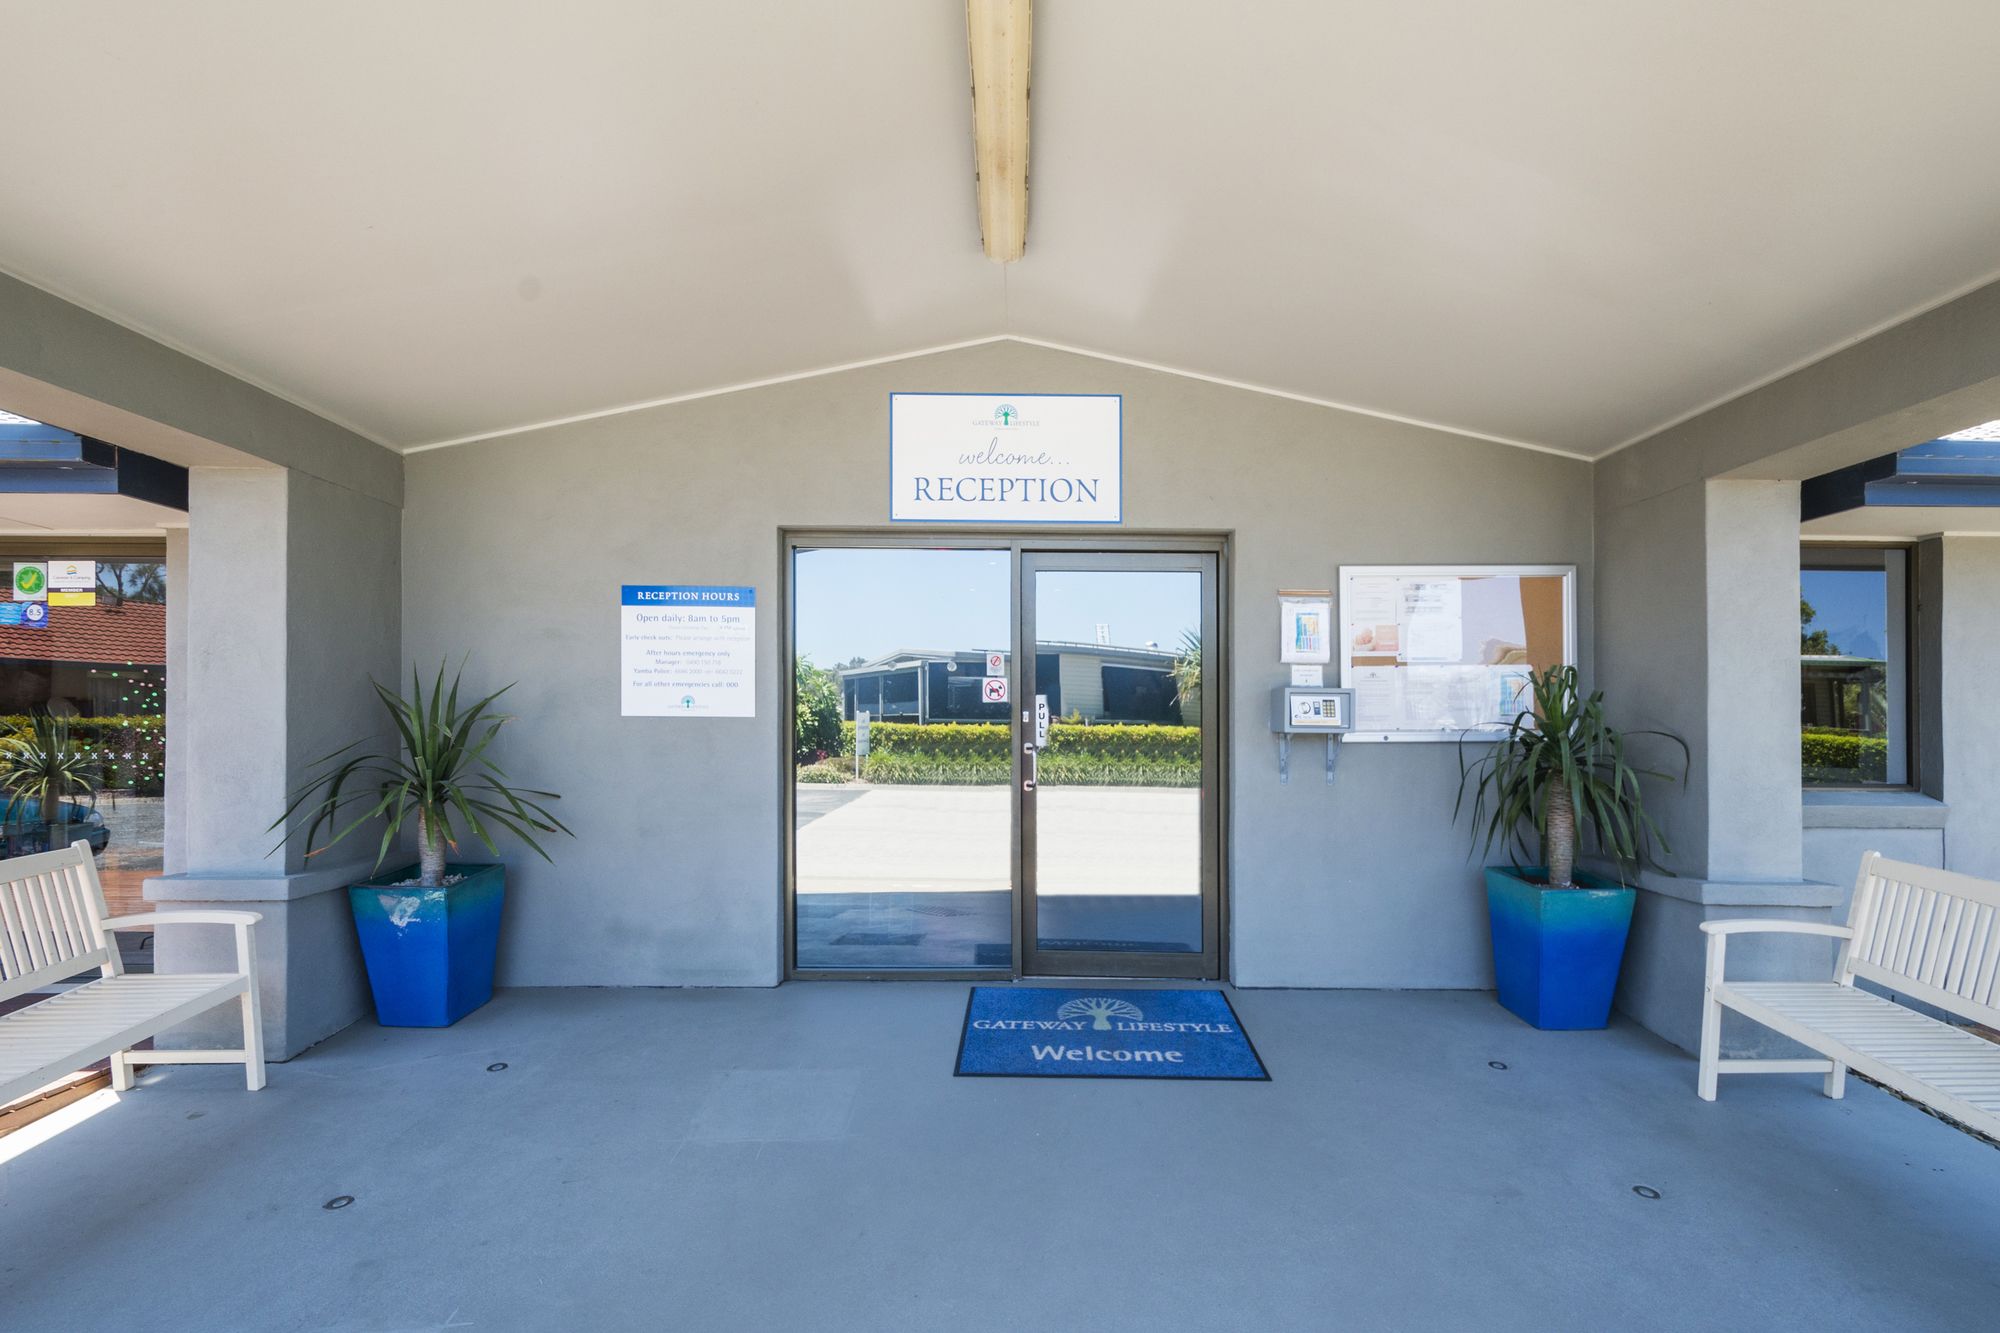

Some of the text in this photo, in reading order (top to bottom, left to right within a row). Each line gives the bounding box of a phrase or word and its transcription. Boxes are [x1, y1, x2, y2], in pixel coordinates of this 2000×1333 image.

[914, 477, 1099, 502] RECEPTION
[637, 591, 740, 601] RECEPTION HOURS
[636, 613, 740, 624] Open daily: 8am to 5pm
[682, 650, 716, 658] emergency
[973, 1020, 1233, 1033] GATEWAY LIFESTYLE
[1031, 1045, 1184, 1063] Welcome
